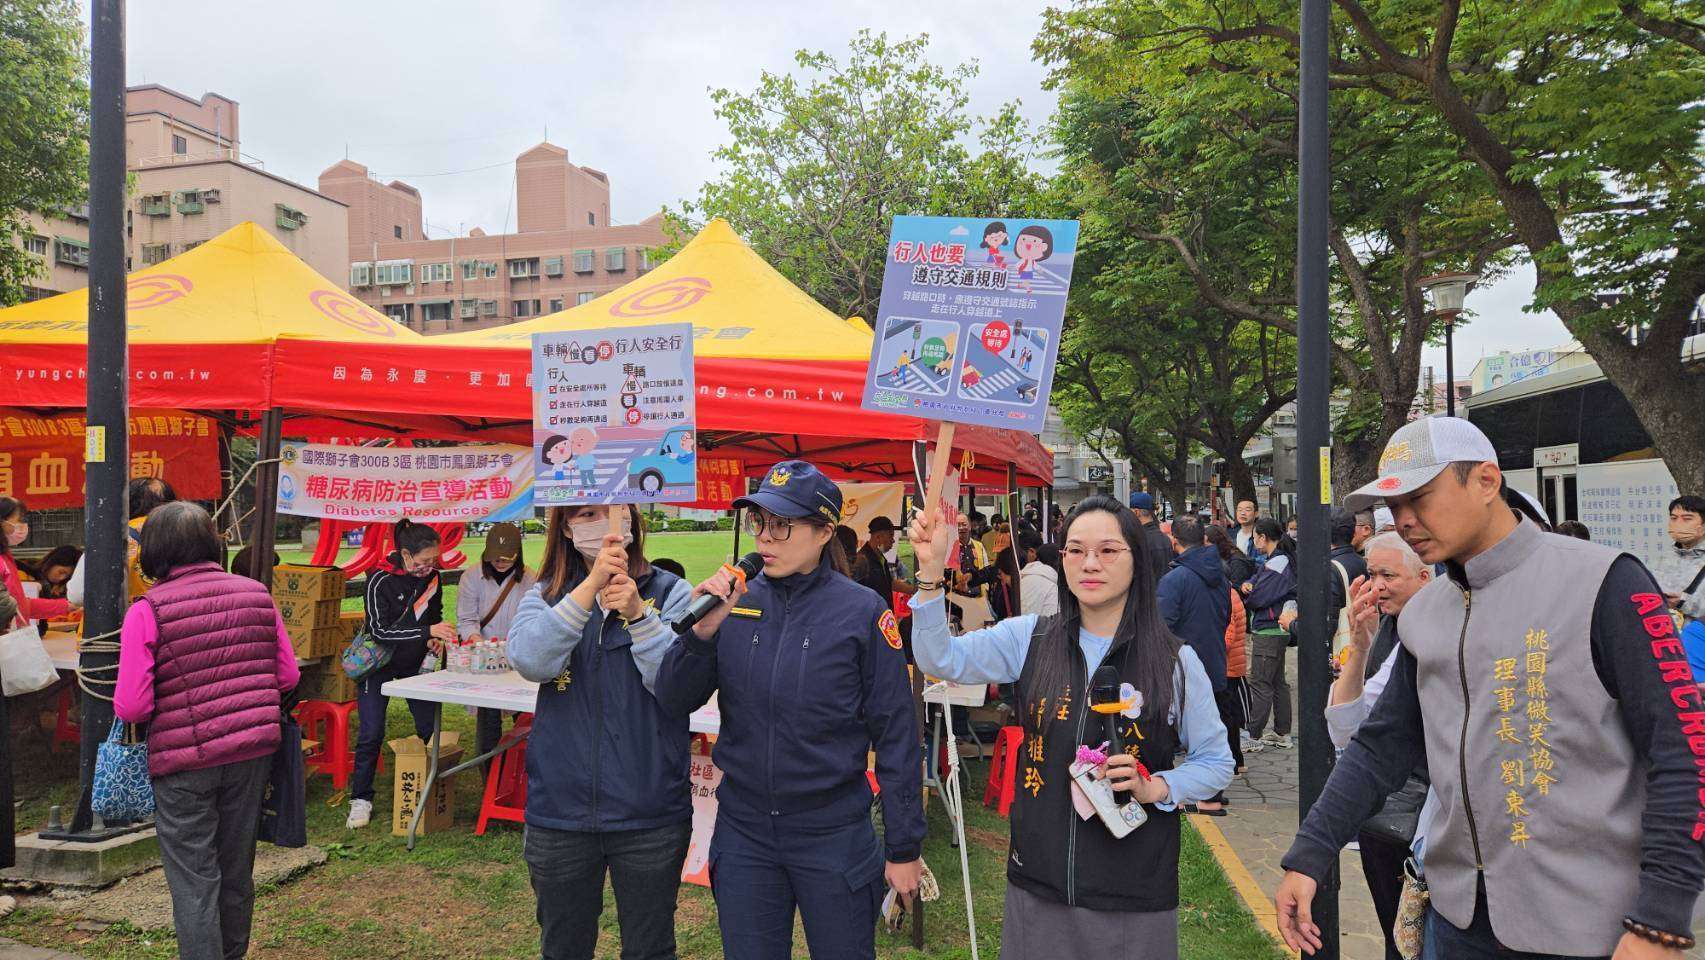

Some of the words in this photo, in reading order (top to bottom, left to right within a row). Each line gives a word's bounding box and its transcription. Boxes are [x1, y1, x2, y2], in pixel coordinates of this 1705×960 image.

[894, 240, 966, 265] 行人也要
[911, 266, 1008, 291] 遵守交通規則
[547, 367, 569, 382] 行人
[393, 456, 411, 470] 3區
[306, 475, 513, 502] 糖尿病防治宣導活動
[324, 504, 398, 517] Diabetes
[402, 505, 489, 517] Resources
[1494, 657, 1522, 745] 理事長
[1525, 628, 1557, 796] 桃園縣微笑協會
[1500, 759, 1531, 849] 劉東昇
